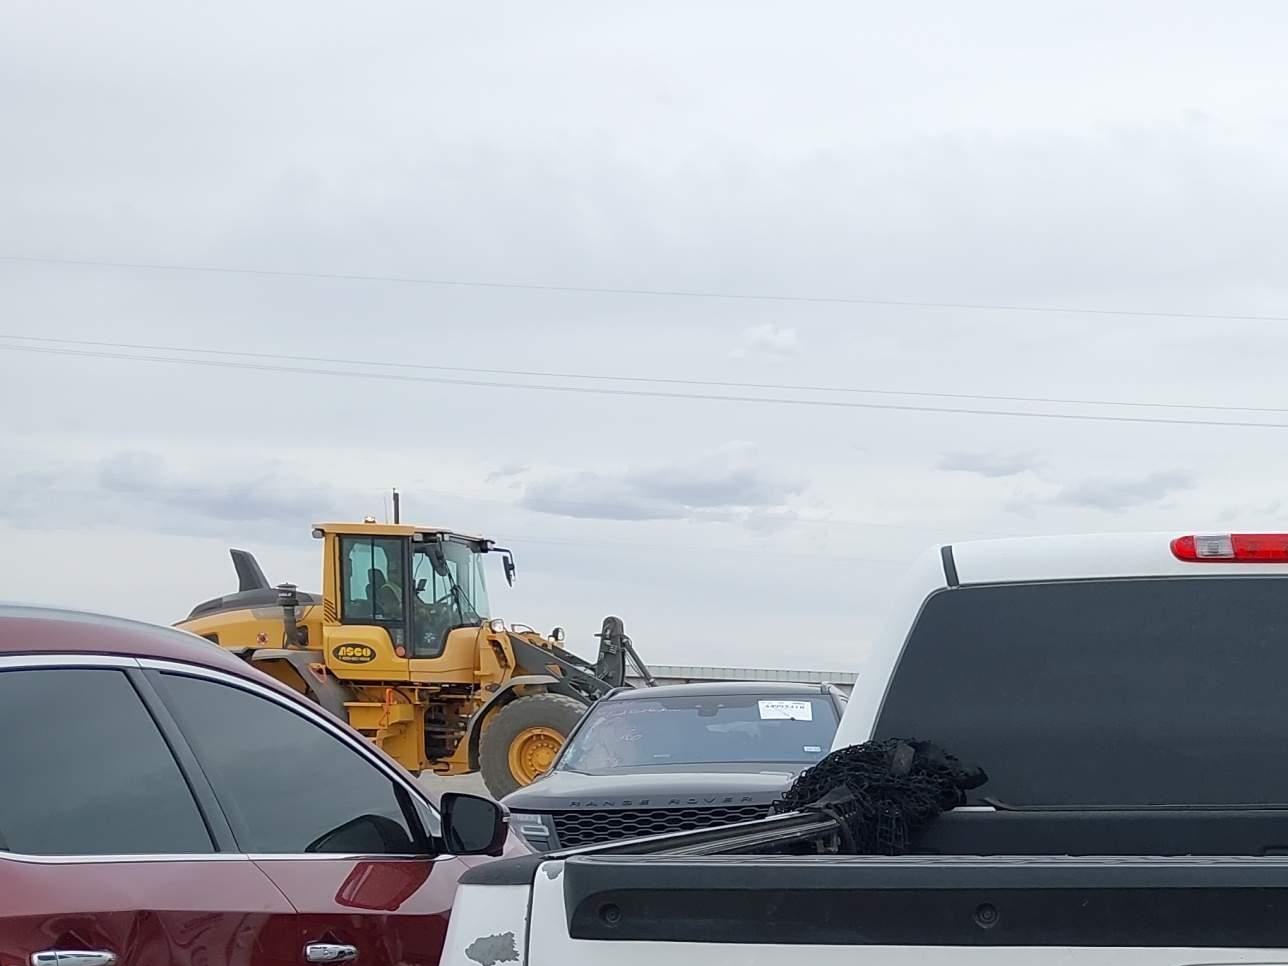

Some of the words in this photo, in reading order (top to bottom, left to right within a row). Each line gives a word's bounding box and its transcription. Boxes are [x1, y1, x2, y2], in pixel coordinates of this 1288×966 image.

[338, 646, 372, 657] ASCO
[569, 799, 650, 808] RANGE
[667, 795, 753, 806] ROVER
